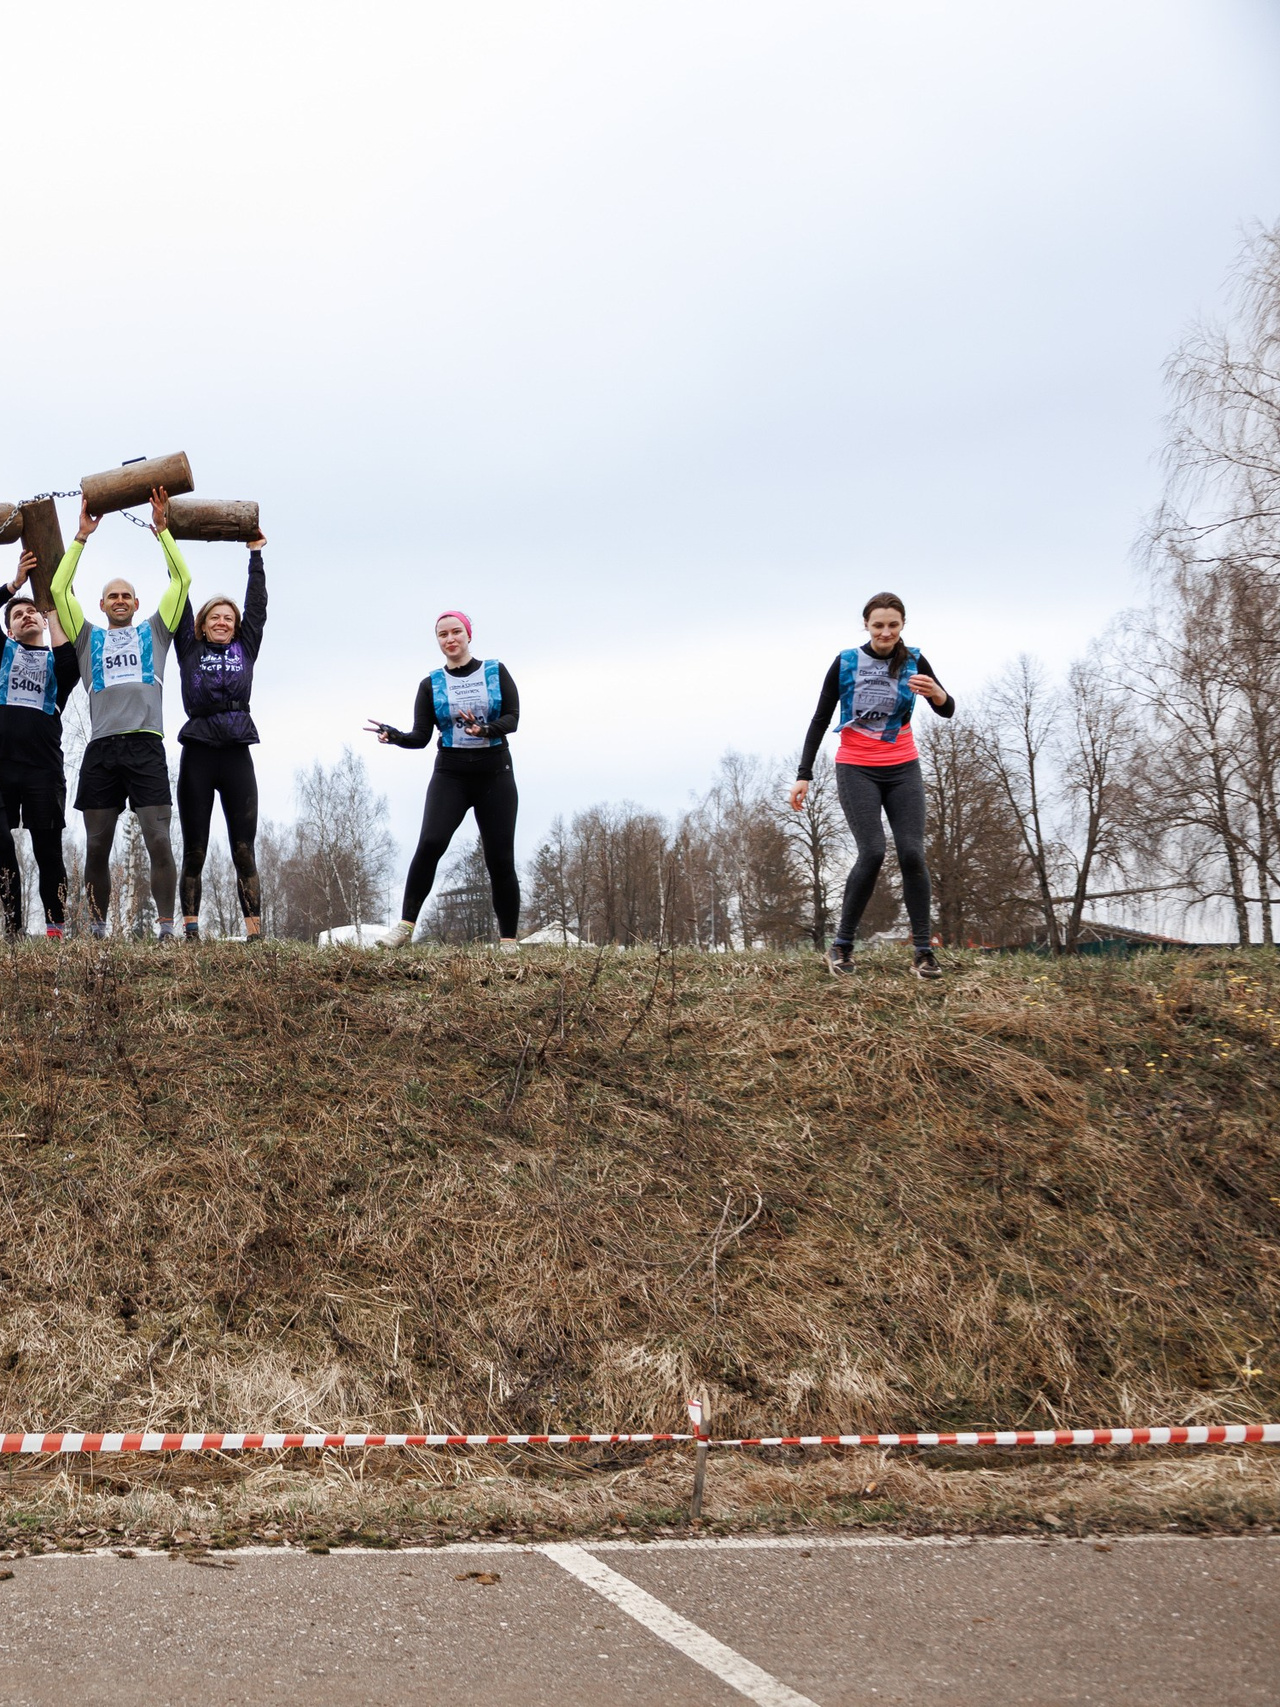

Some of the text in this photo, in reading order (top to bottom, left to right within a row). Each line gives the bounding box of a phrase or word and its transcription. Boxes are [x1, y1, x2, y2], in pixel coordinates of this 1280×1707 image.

[105, 653, 138, 669] 5410
[11, 677, 42, 695] 5404
[863, 678, 891, 687] Sminex
